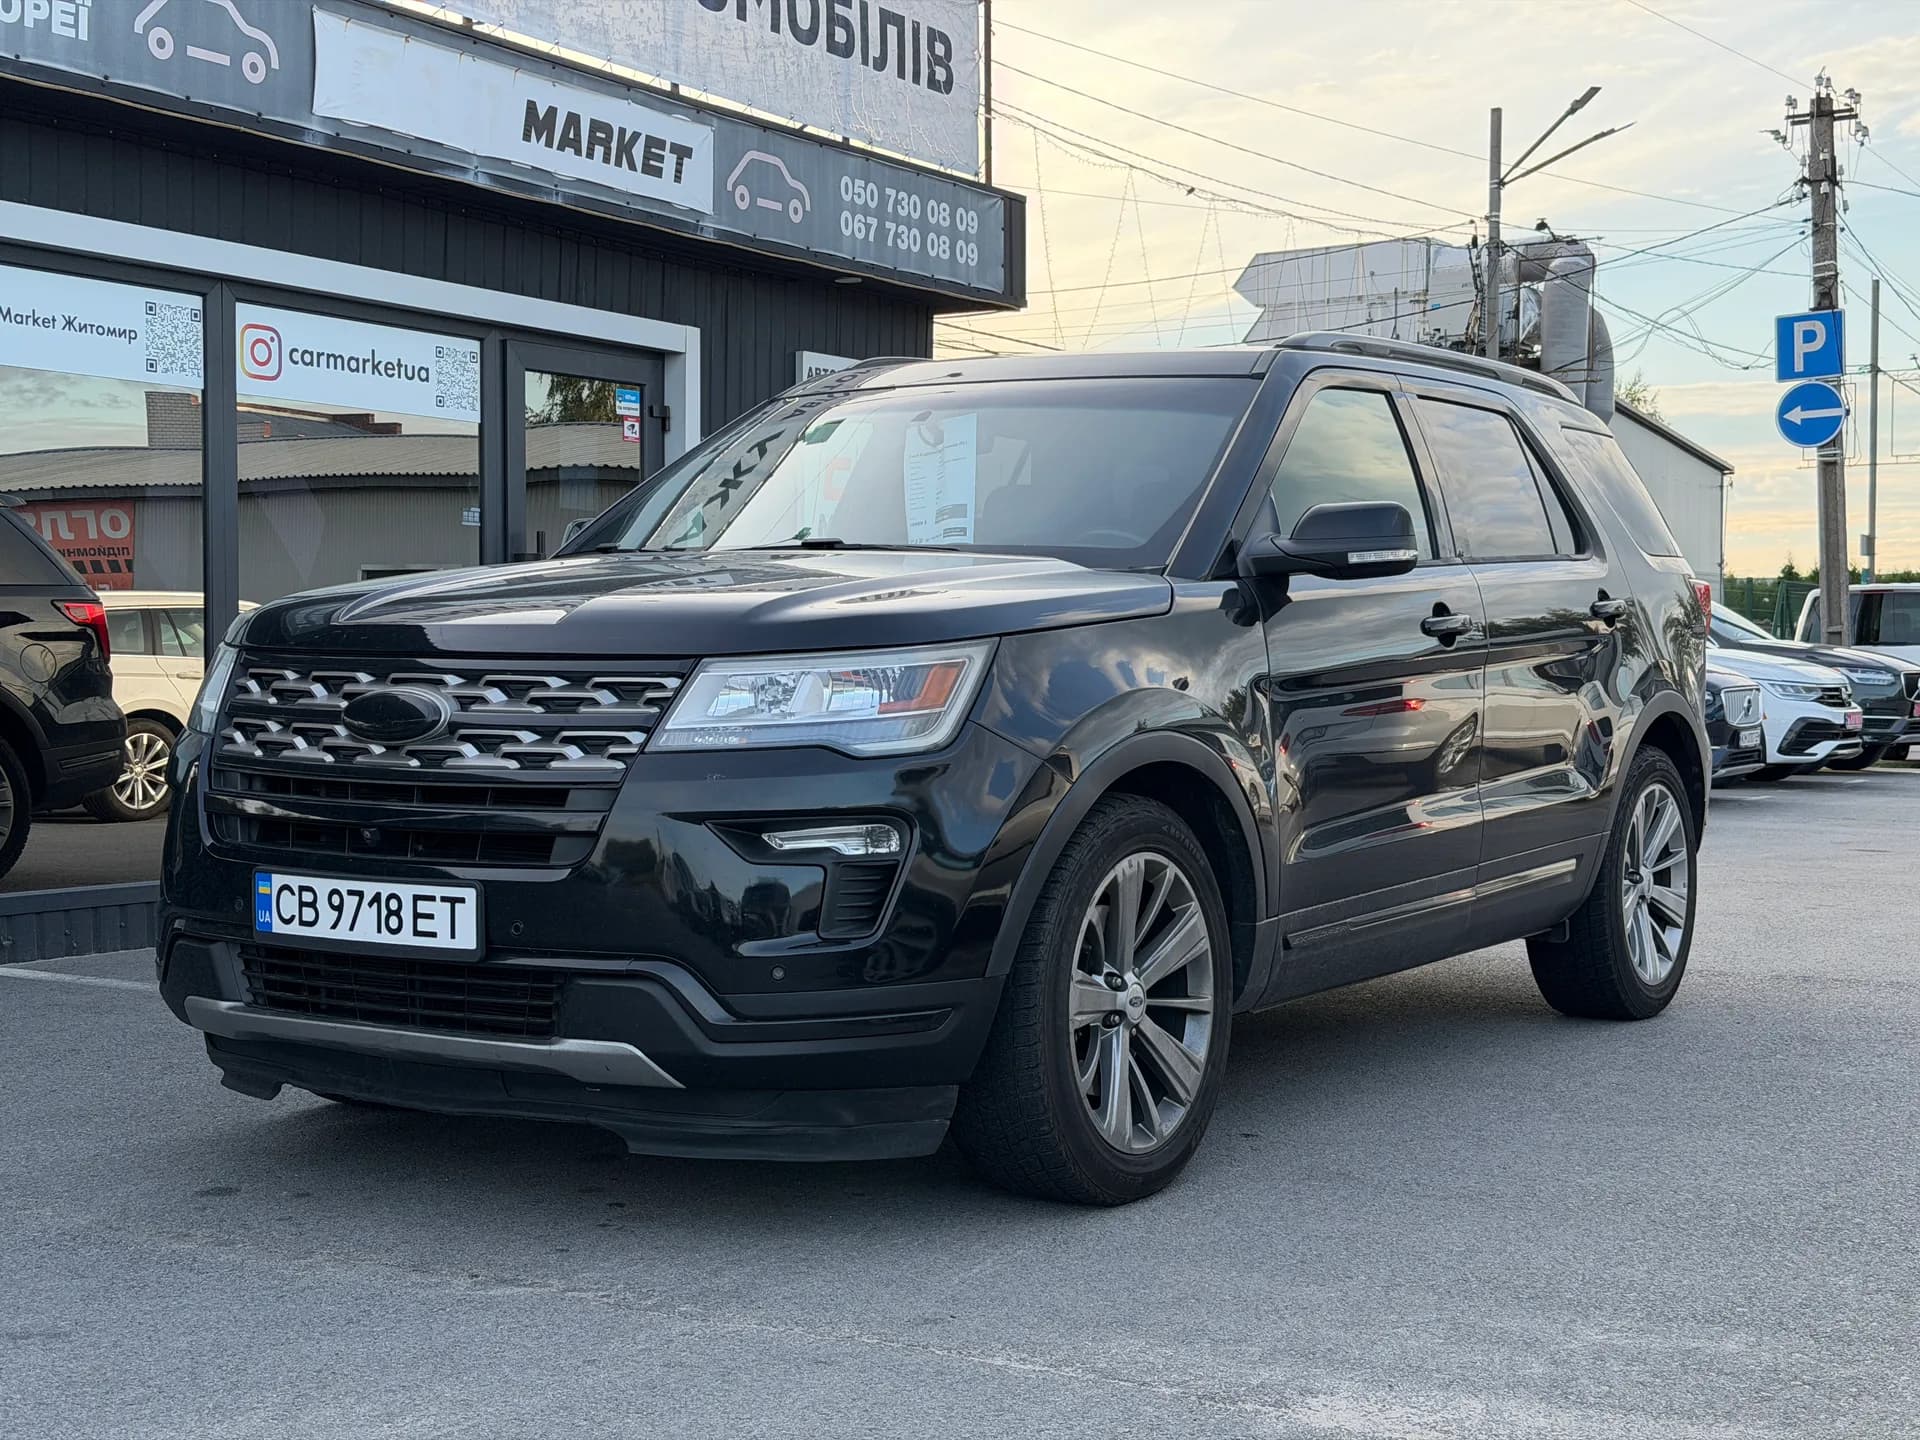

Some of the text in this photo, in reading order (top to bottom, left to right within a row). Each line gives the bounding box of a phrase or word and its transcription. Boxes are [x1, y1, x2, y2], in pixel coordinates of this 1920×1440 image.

[522, 99, 693, 184] MARKET
[840, 176, 978, 234] 050 730 08 09
[840, 210, 978, 266] 067 730 08 09
[0, 305, 138, 345] Market Житомир
[1793, 320, 1826, 373] P
[288, 347, 430, 383] carmarketua
[258, 909, 271, 924] UA
